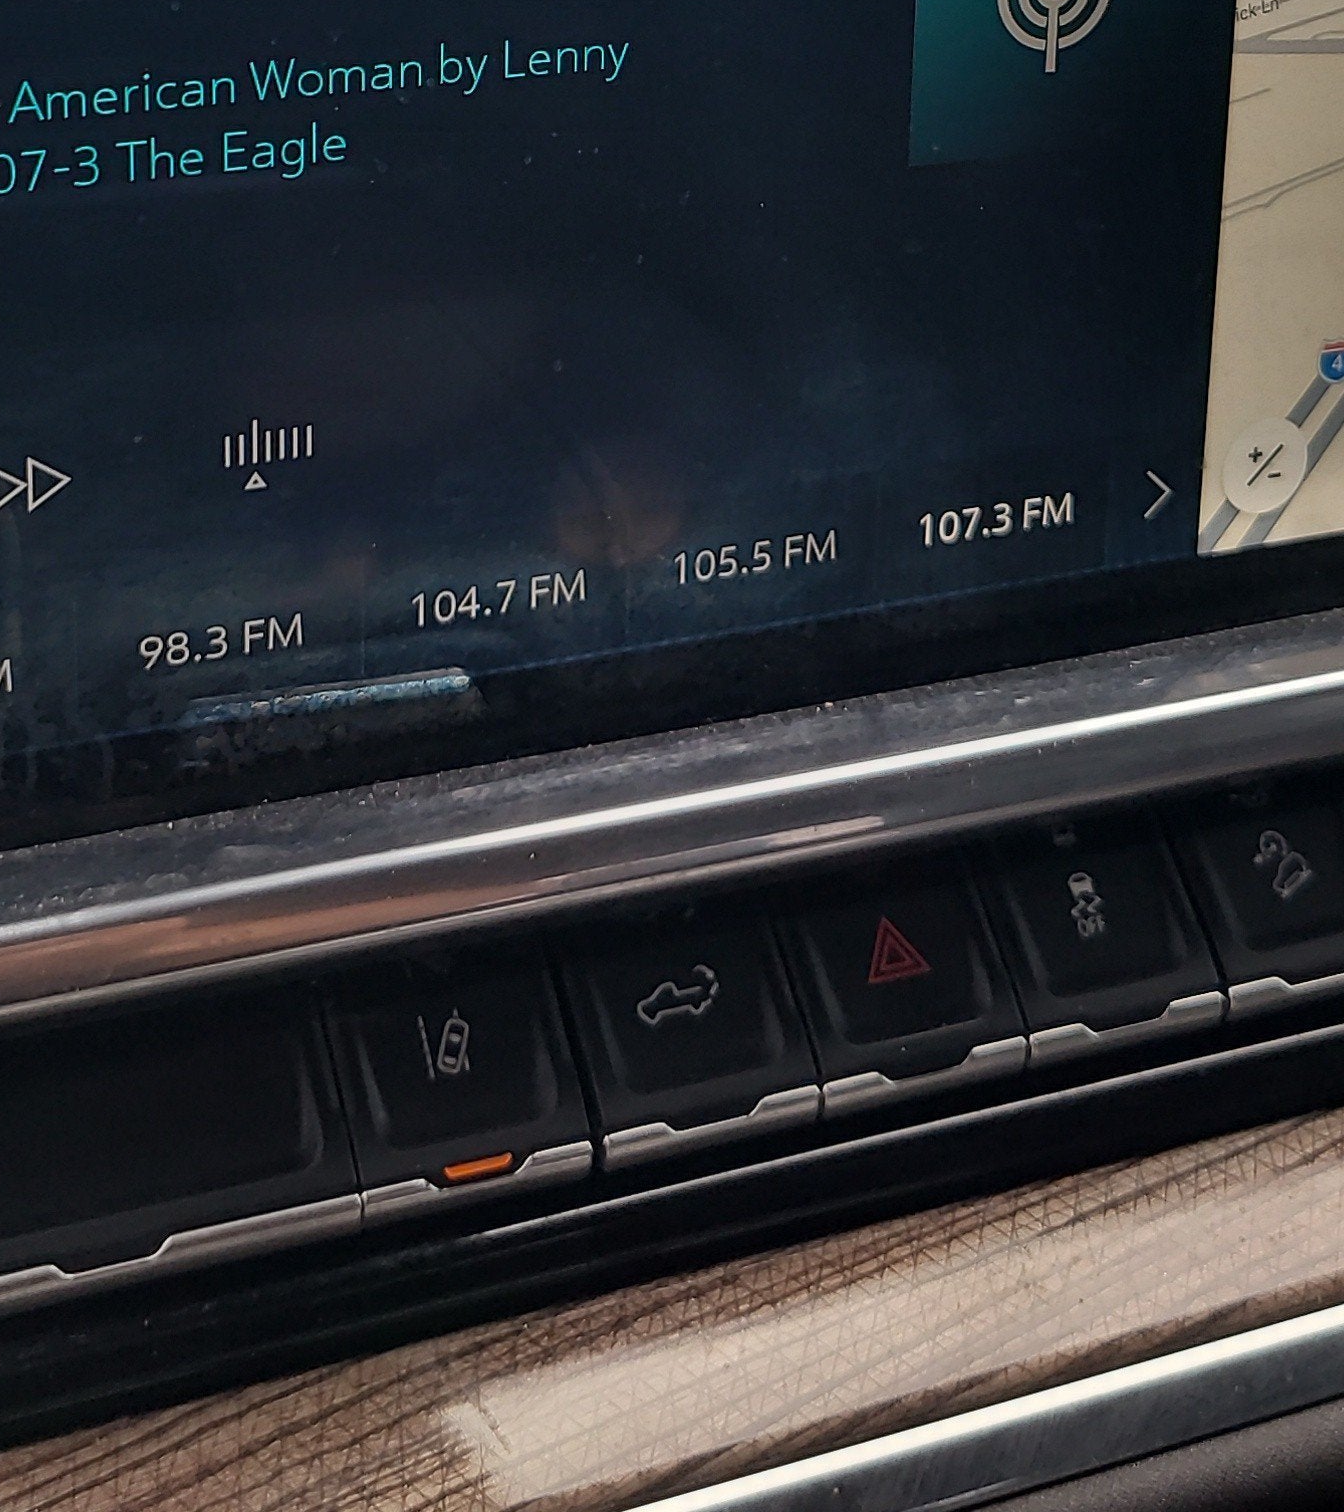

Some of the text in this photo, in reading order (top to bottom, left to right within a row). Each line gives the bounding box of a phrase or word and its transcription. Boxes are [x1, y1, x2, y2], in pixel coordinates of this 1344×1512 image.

[1261, 0, 1279, 14] Ln
[8, 73, 235, 124] American
[249, 57, 423, 101] Woman
[440, 42, 488, 95] by
[503, 39, 630, 82] Lenny
[115, 136, 203, 182] The
[222, 122, 348, 179] Eagle
[1331, 354, 1343, 372] 4
[918, 492, 1075, 548] 107.3 FM
[674, 529, 838, 585] 105.5 FM
[410, 568, 588, 628] 104.7 FM
[138, 613, 304, 671] 98.3 FM
